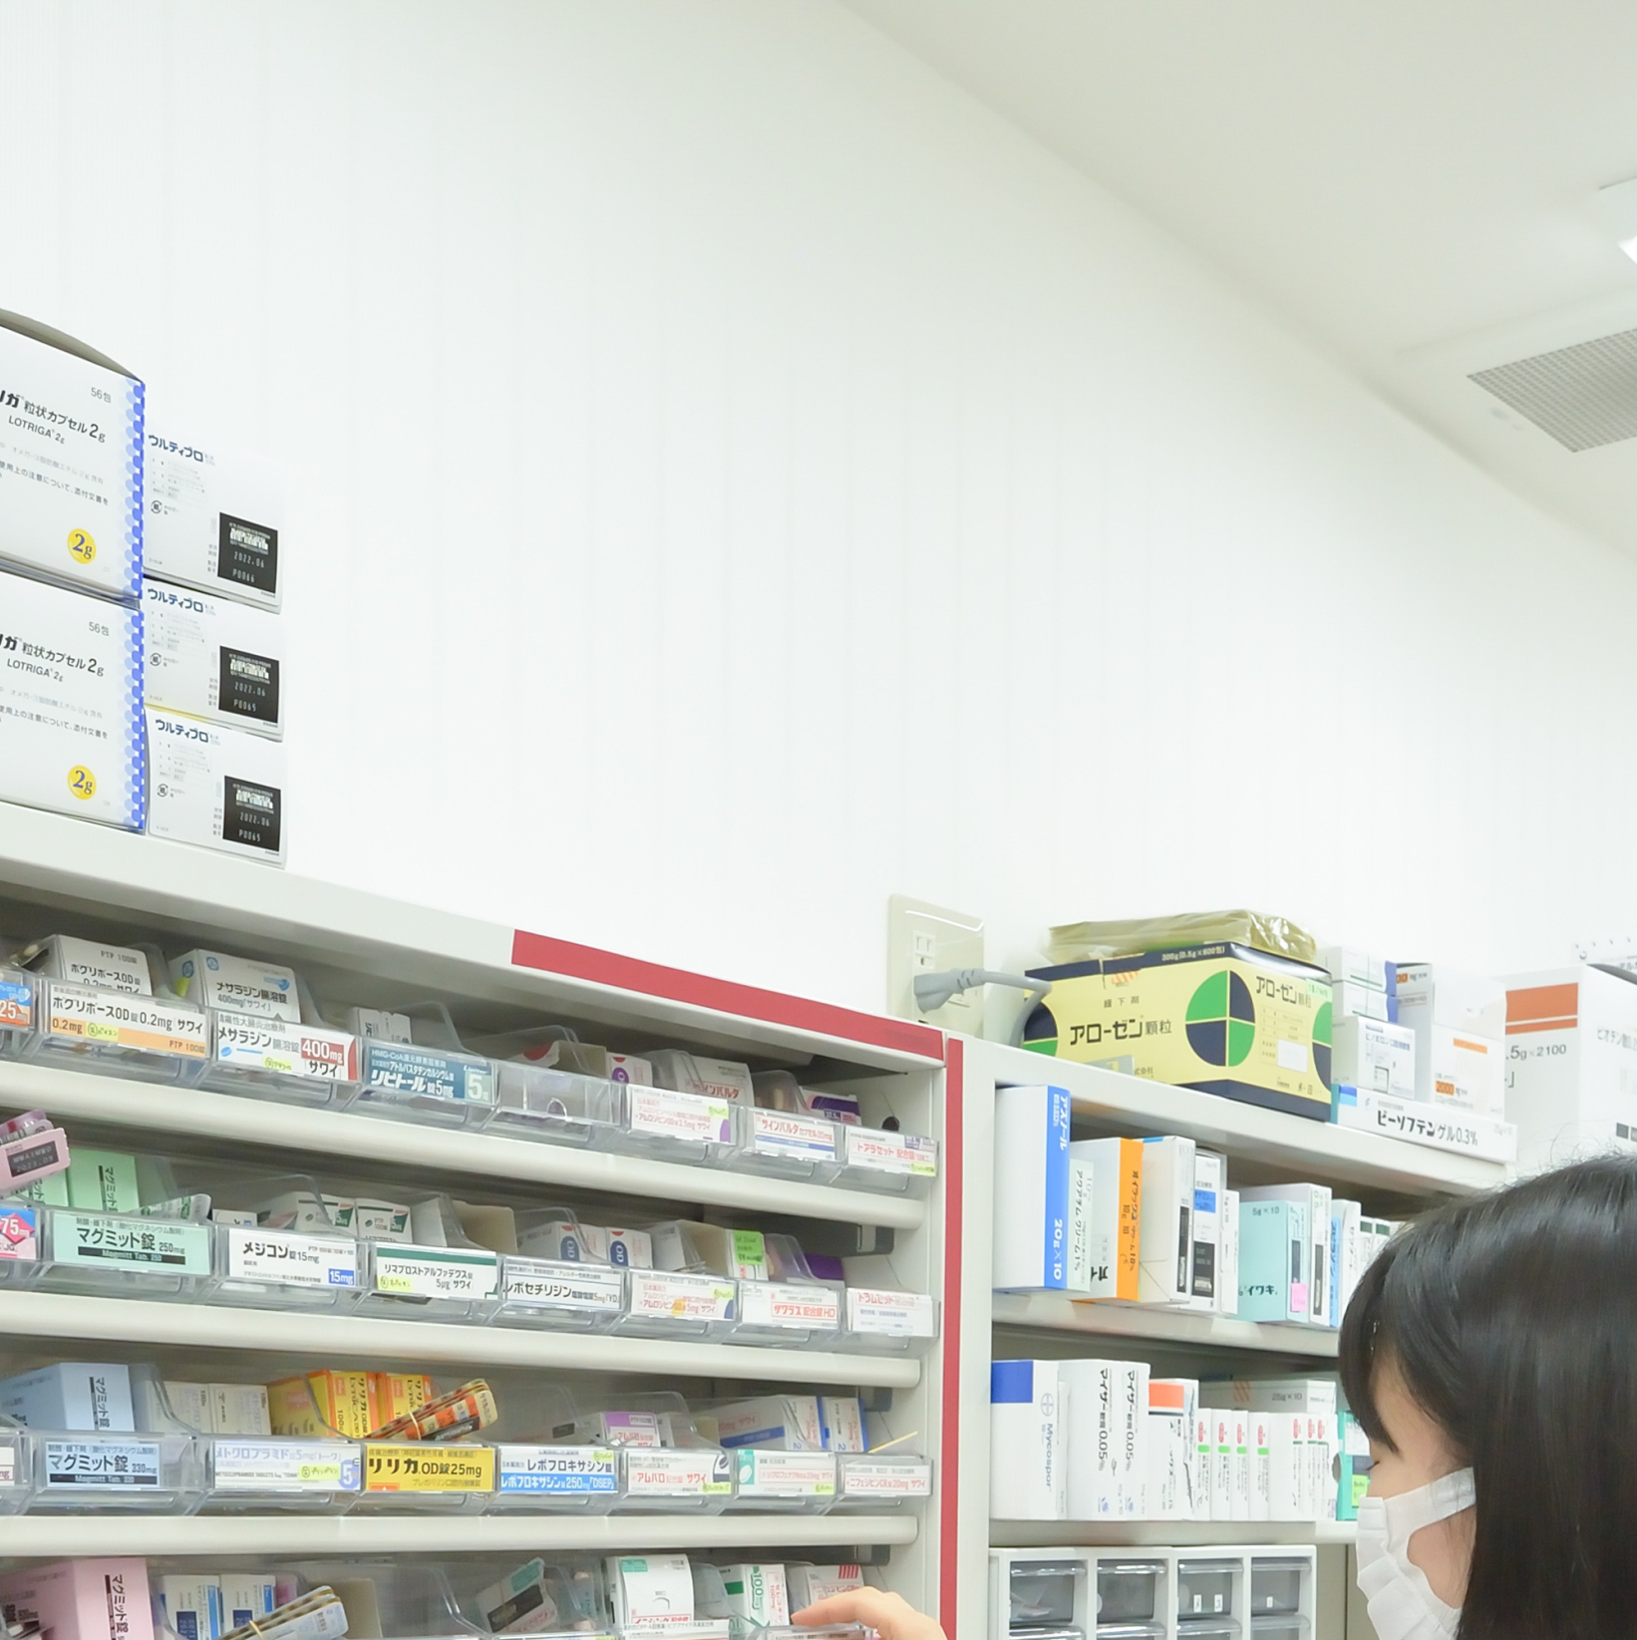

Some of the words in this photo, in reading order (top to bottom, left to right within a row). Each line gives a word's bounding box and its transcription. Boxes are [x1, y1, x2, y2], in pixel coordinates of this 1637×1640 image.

[90, 386, 112, 405] 56包
[71, 533, 94, 560] 2g
[88, 620, 110, 637] 56包
[72, 768, 95, 799] 2g
[52, 1019, 83, 1035] 0.2mg
[301, 1040, 344, 1064] 400mg
[158, 1240, 186, 1255] 250mg
[329, 1271, 354, 1285] 15mg
[131, 1462, 158, 1475] 330mg
